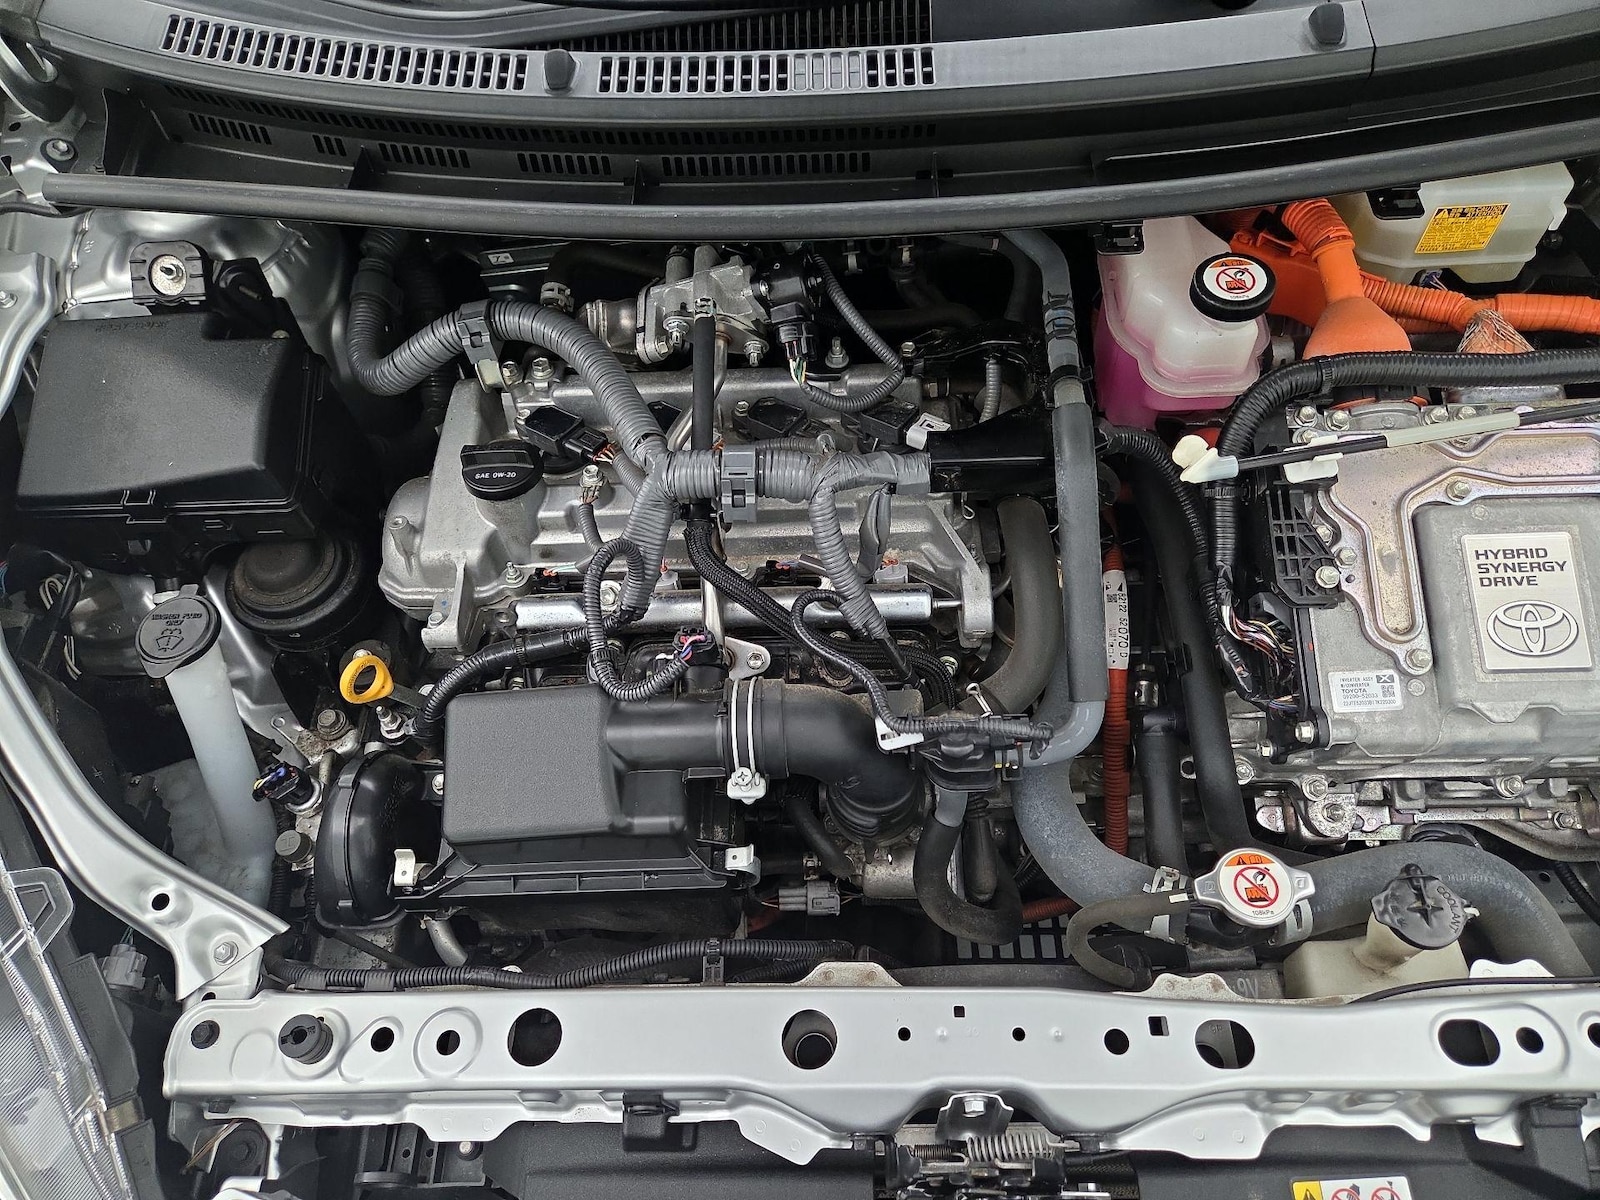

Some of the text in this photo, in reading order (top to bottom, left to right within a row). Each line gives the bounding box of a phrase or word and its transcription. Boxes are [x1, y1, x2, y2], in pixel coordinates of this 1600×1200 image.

[474, 471, 517, 480] SAE 0W-20
[1474, 547, 1548, 561] HYBRID
[1477, 561, 1568, 574] SYNERGY
[1479, 575, 1539, 588] DRIVE
[1436, 885, 1461, 934] COOLANT
